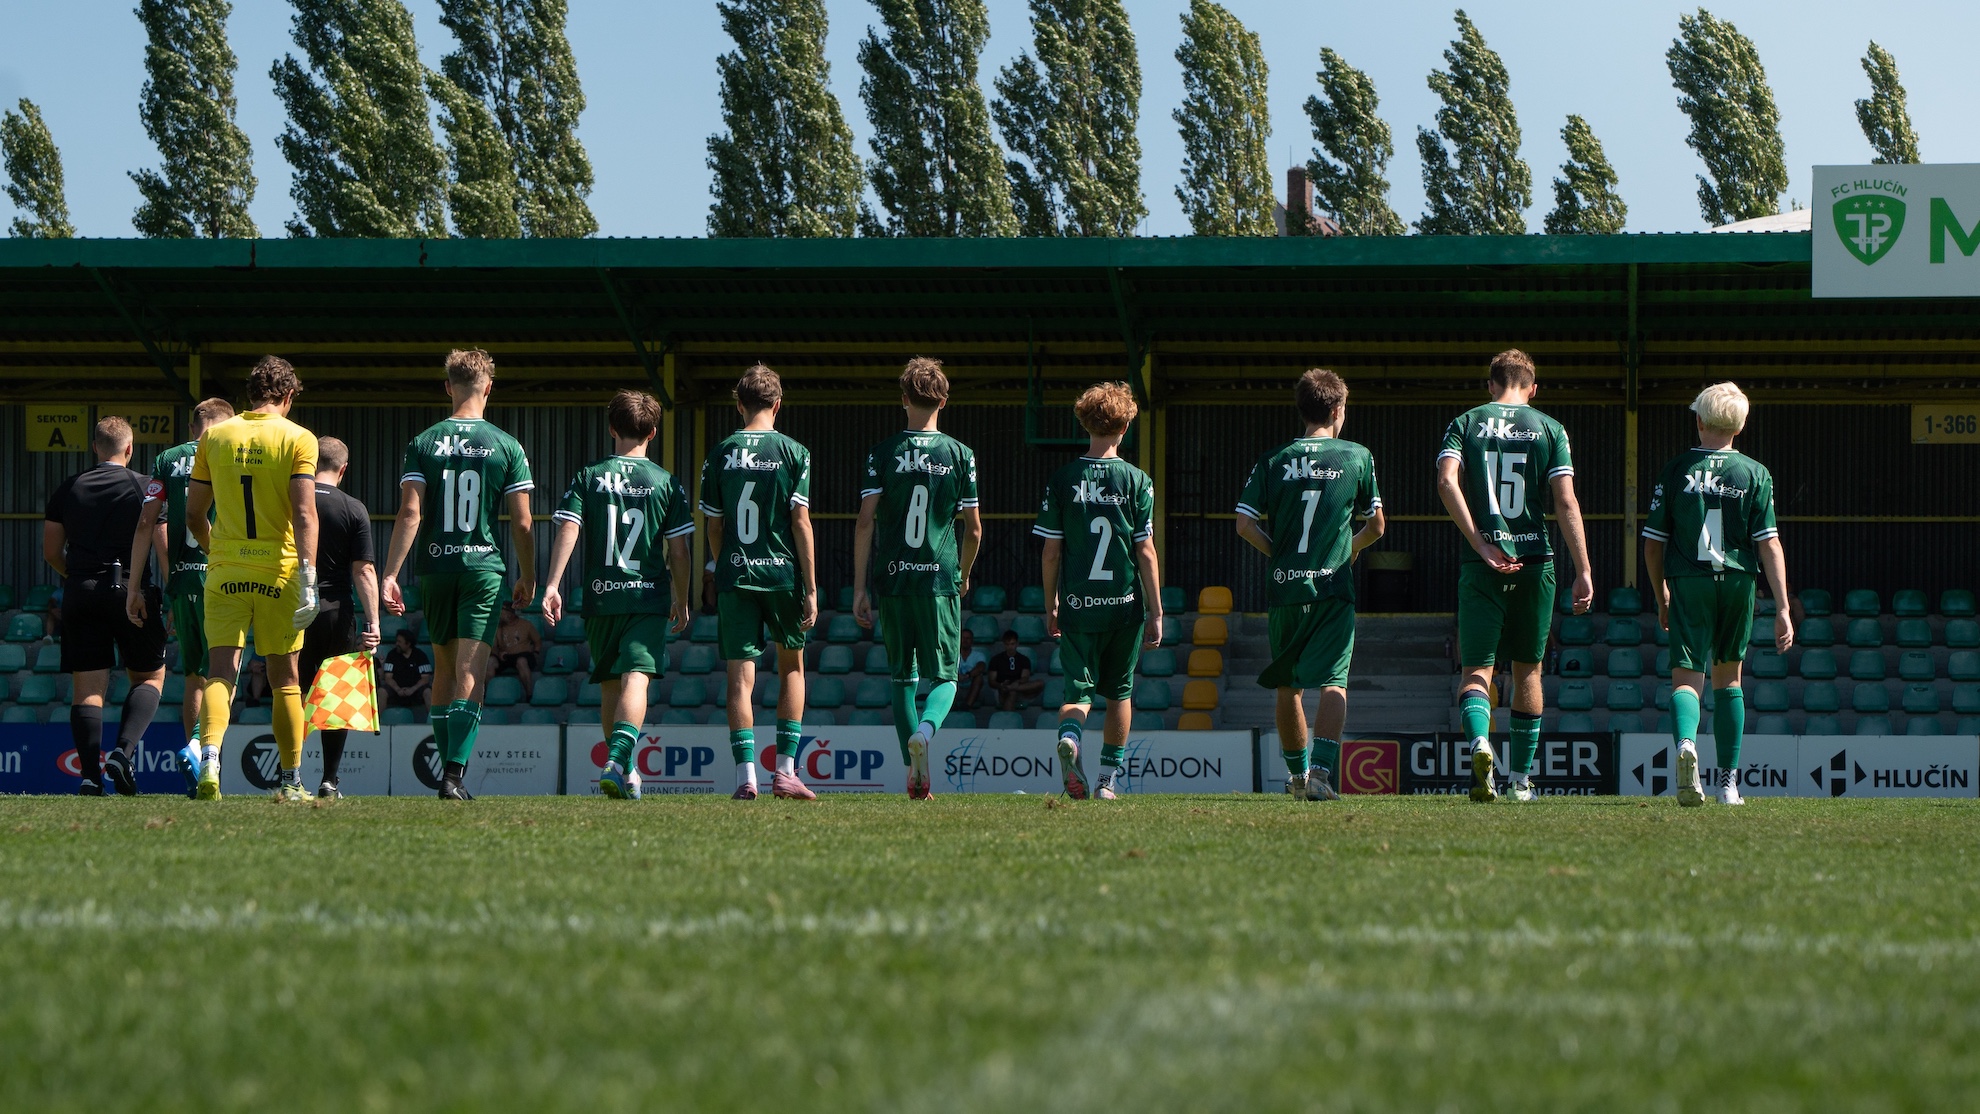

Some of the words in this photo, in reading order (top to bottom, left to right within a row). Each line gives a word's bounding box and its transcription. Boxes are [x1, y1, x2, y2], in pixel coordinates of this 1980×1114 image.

[1831, 183, 1850, 198] FC
[1853, 179, 1908, 197] HLUČÍN
[37, 414, 78, 423] SEKTOR
[48, 427, 67, 448] A
[1924, 414, 1977, 435] 1-366
[443, 469, 481, 533] 18
[1485, 450, 1527, 520] 15
[240, 474, 257, 540] 1
[737, 481, 760, 545] 6
[905, 484, 929, 549] 8
[1297, 490, 1322, 554] 7
[605, 504, 645, 571] 12
[1088, 516, 1114, 581] 2
[1697, 508, 1726, 572] 4
[220, 581, 282, 600] TOMPRES
[604, 580, 655, 592] Bavamex
[1084, 592, 1135, 608] Bavamex
[478, 751, 500, 759] VZV
[507, 751, 542, 759] STEEL
[637, 736, 715, 777] ČPP
[806, 739, 885, 780] ČPP
[944, 755, 1053, 777] SEADON
[1873, 764, 1969, 789] HLUČÍN
